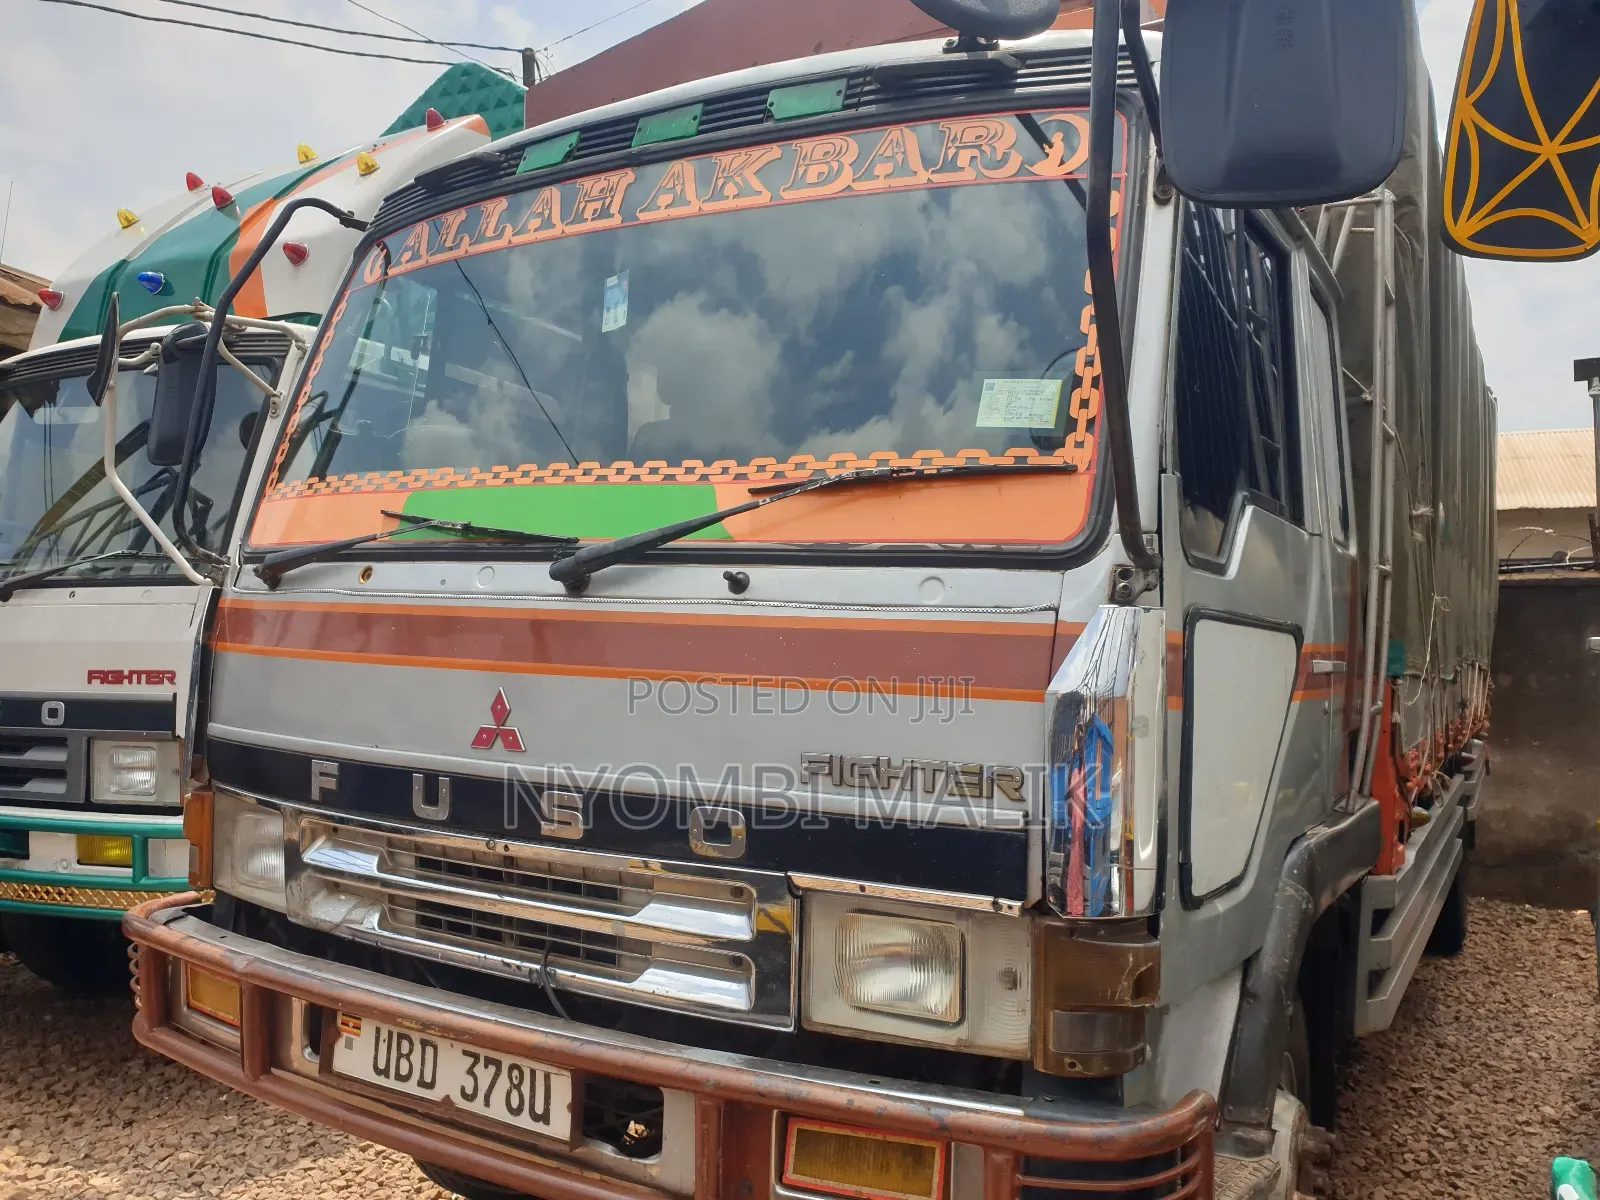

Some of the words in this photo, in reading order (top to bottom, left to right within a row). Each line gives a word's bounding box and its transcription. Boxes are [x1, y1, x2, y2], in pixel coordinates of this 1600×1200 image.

[387, 169, 636, 276] ALLAH
[636, 118, 1022, 219] AKBAR
[87, 669, 177, 686] FIGHTER
[310, 758, 748, 860] FUSO
[800, 752, 1026, 802] FIGHTER
[372, 1026, 439, 1091] UBD
[459, 1048, 552, 1126] 378U
